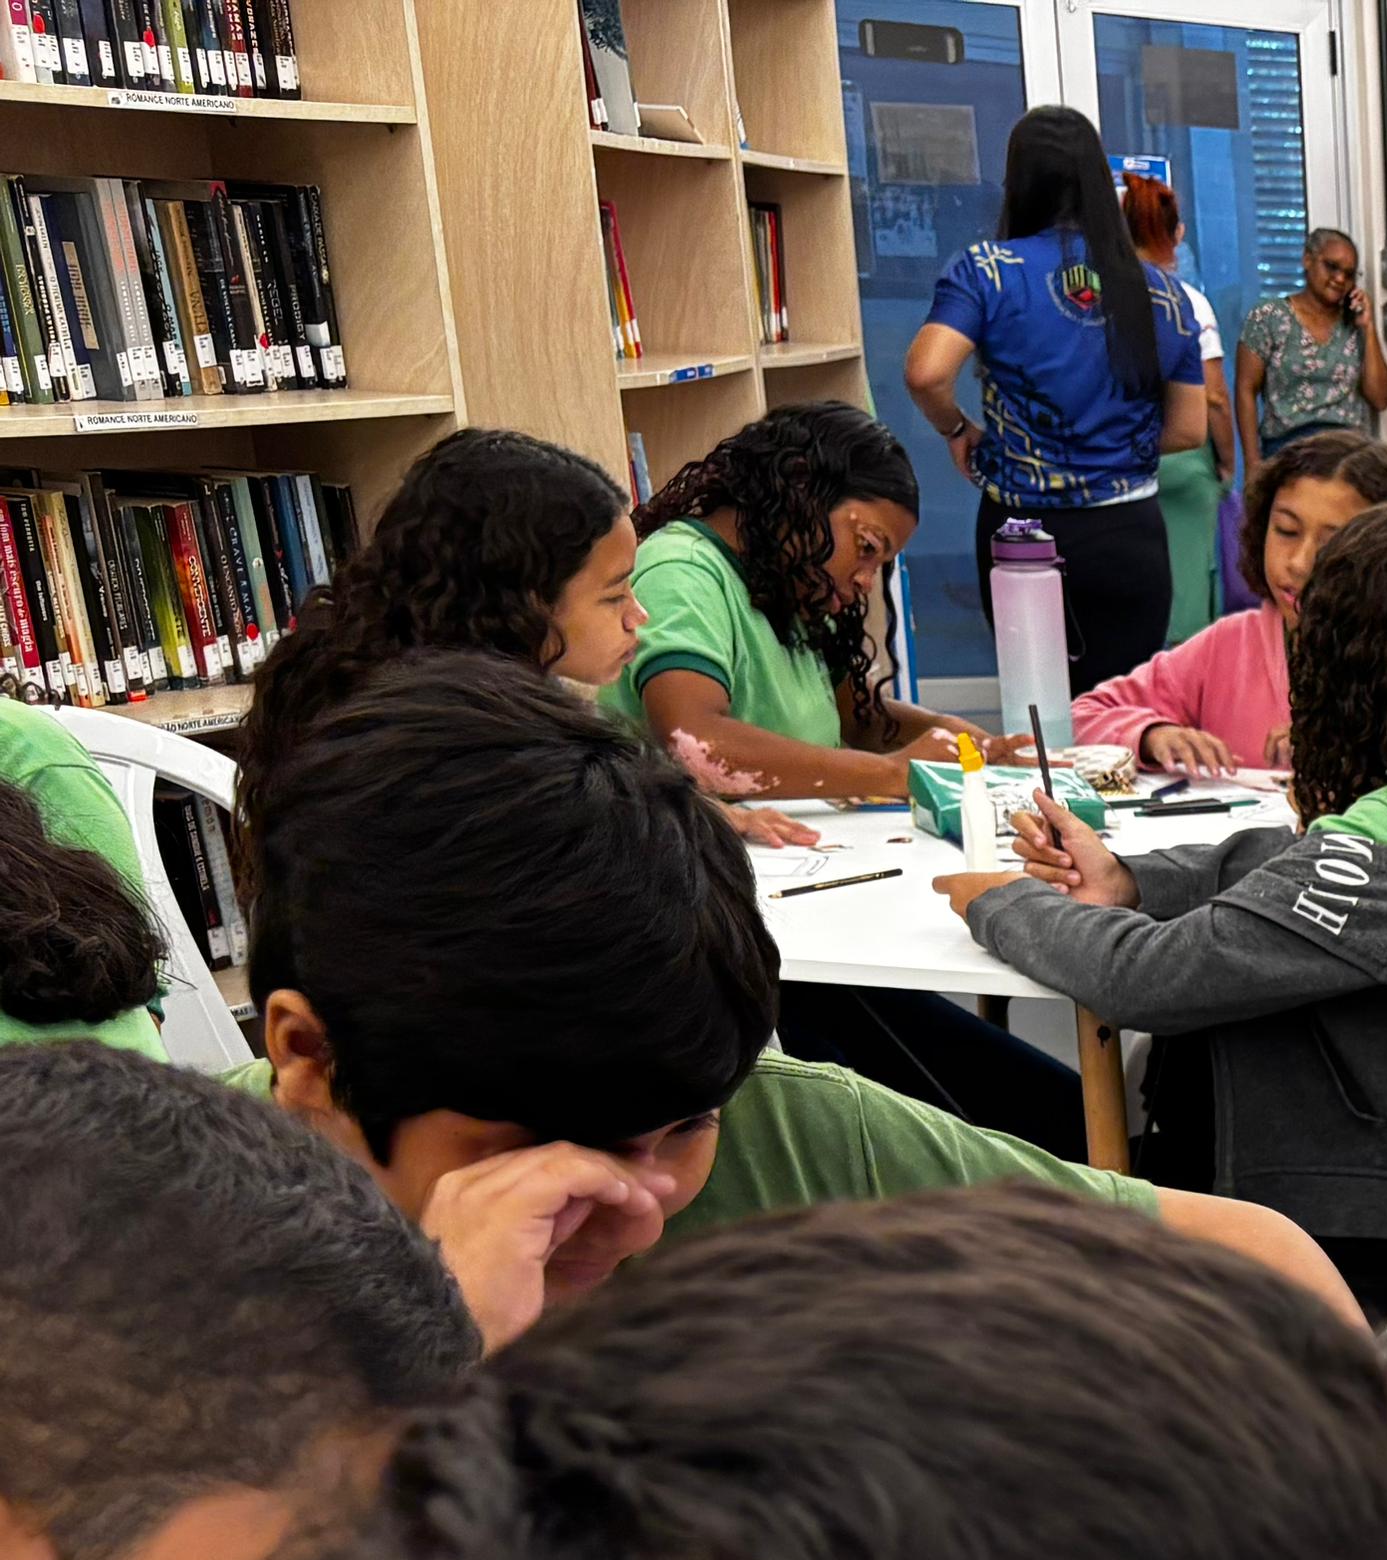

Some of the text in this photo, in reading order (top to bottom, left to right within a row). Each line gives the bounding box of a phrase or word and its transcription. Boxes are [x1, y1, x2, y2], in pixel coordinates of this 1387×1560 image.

[125, 92, 235, 109] ROMANCE NORTE AMERICANO
[288, 284, 306, 341] PRODIGY
[87, 413, 198, 425] ROMANCE NORTE AMERICANO
[18, 617, 35, 653] magia
[178, 720, 202, 731] NORTE
